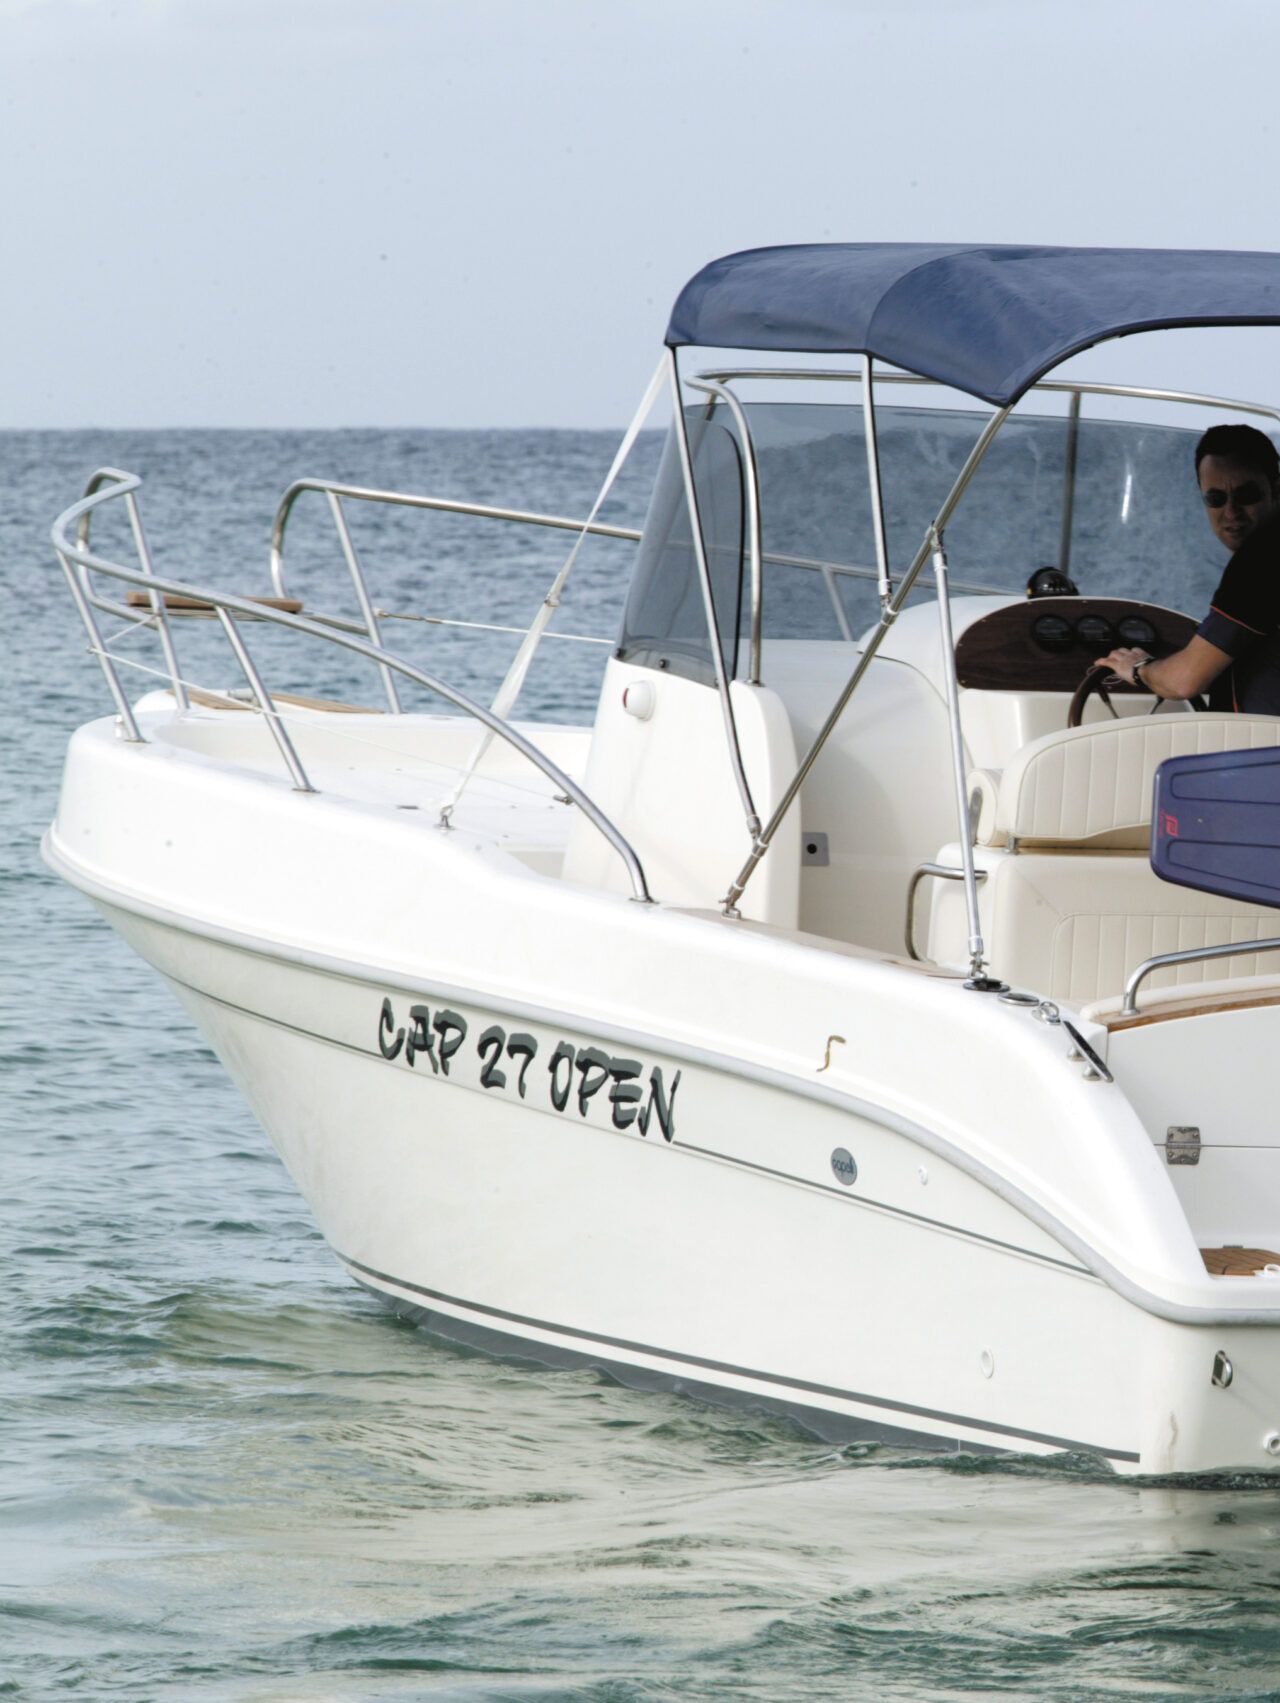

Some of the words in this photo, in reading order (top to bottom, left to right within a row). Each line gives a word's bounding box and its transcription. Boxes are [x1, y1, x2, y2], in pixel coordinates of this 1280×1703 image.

[378, 997, 467, 1076] CAP
[477, 1024, 538, 1099] 27
[548, 1040, 682, 1144] OPEN
